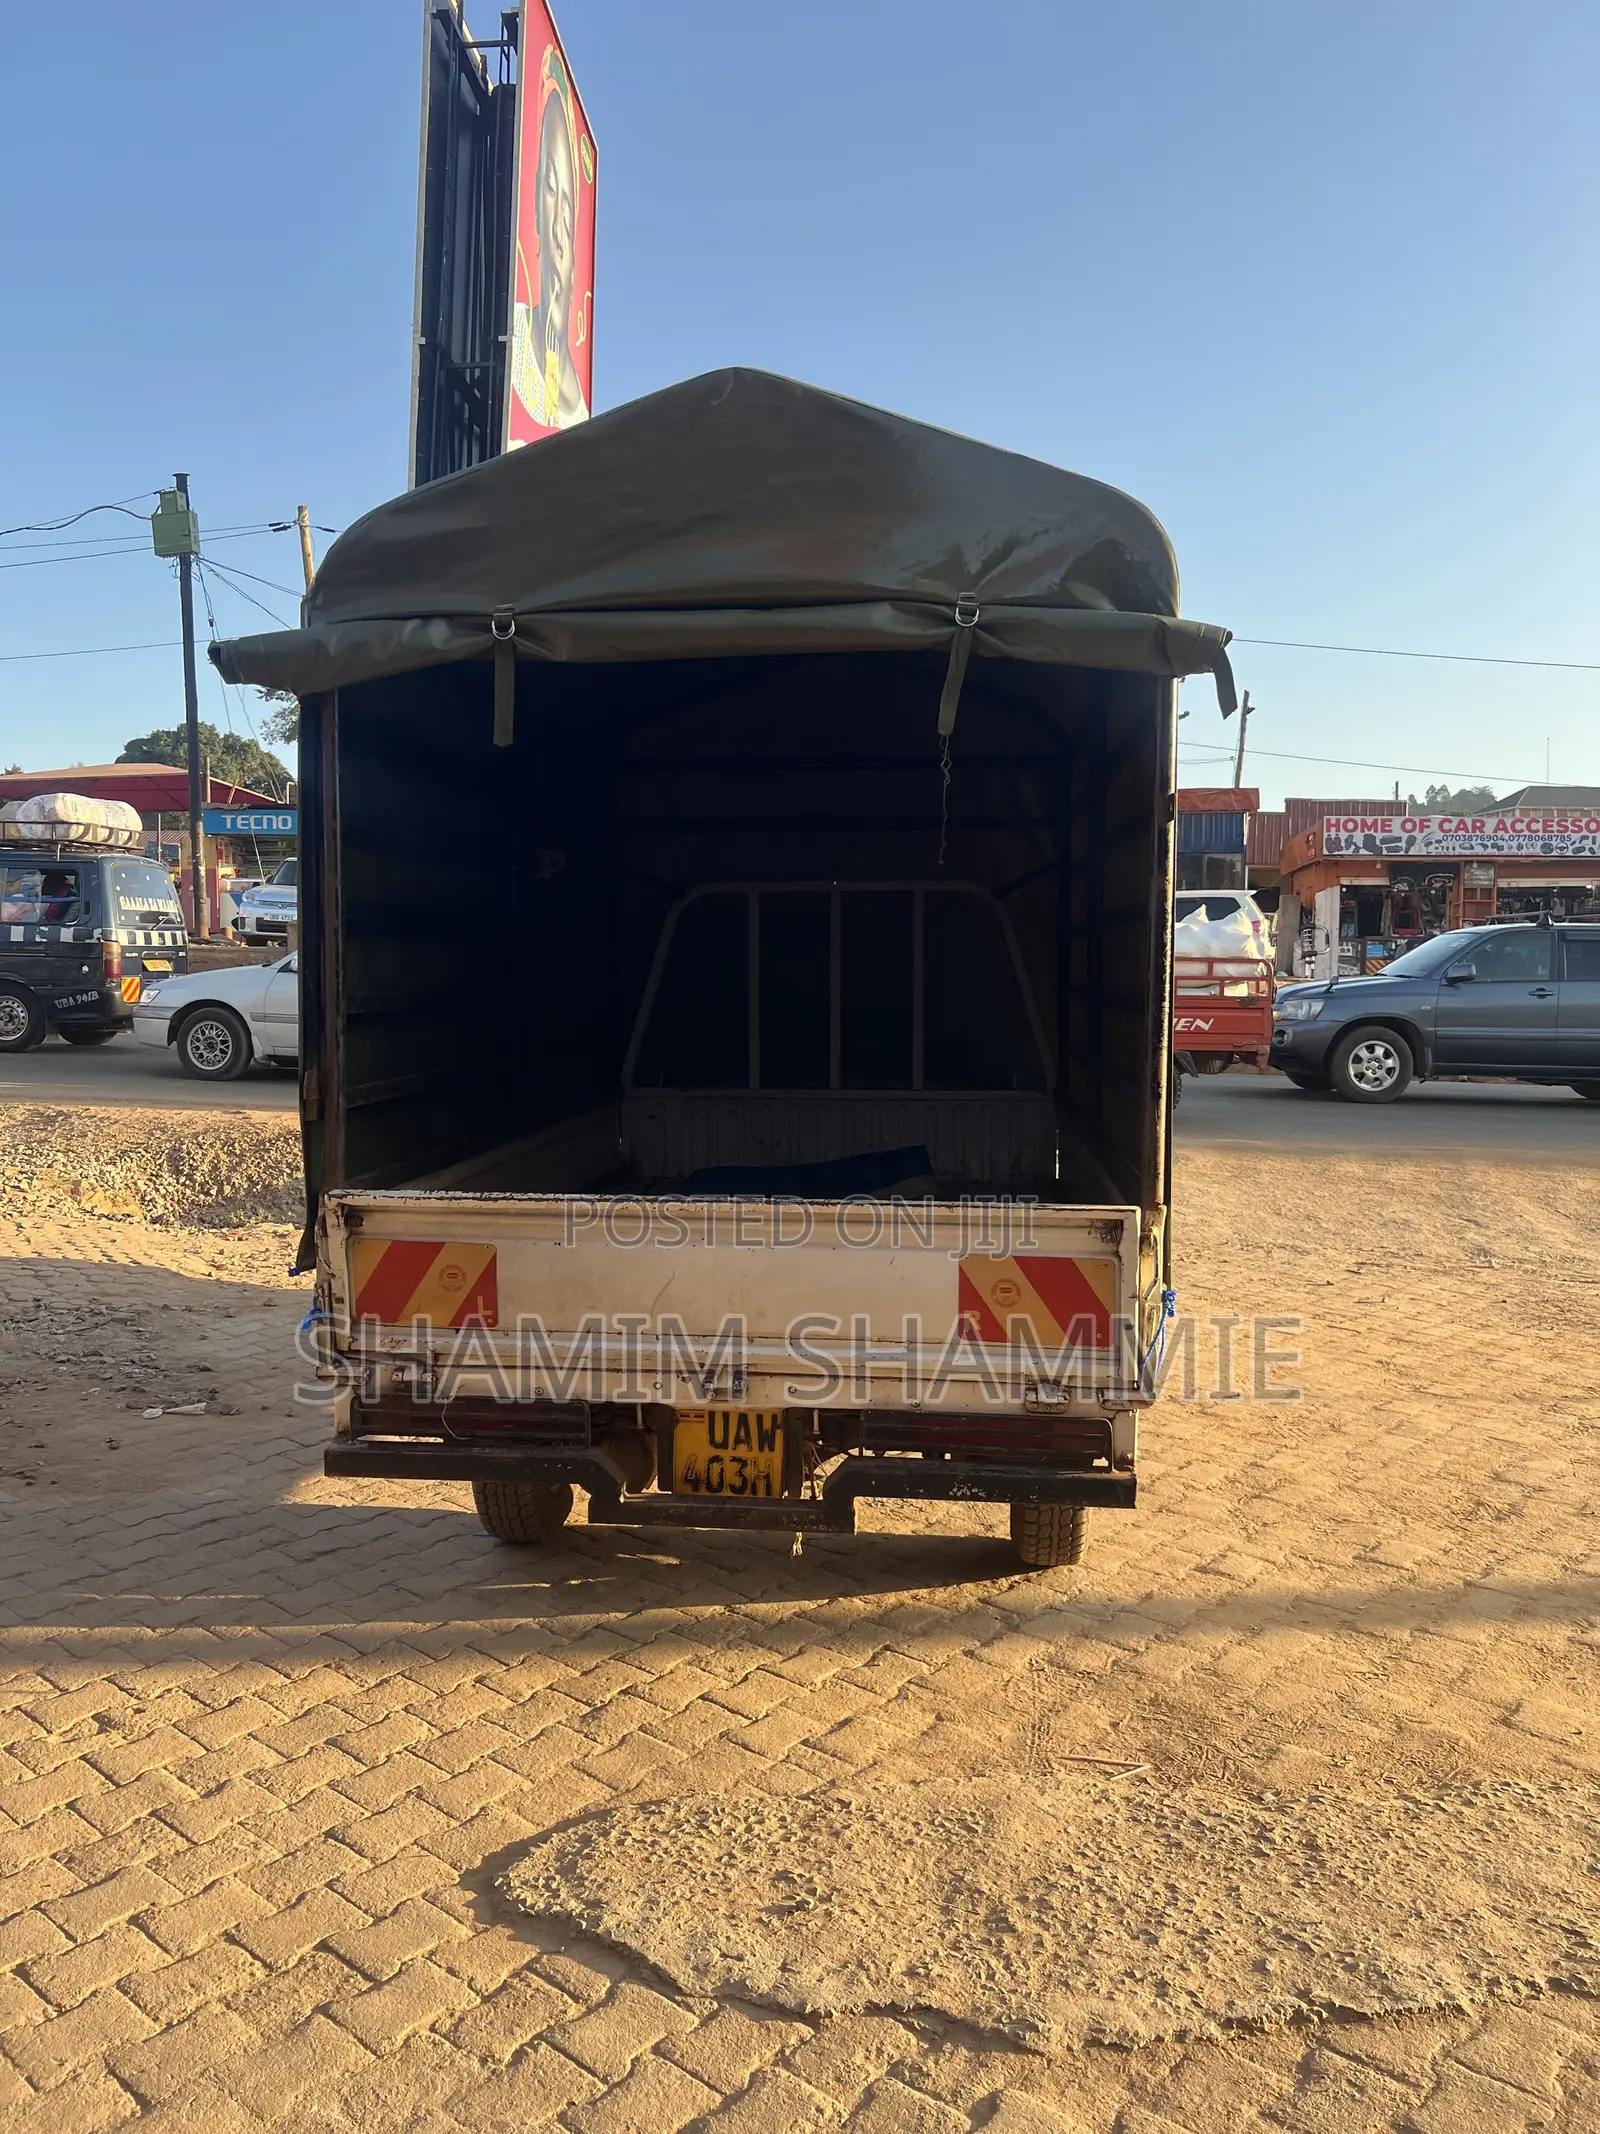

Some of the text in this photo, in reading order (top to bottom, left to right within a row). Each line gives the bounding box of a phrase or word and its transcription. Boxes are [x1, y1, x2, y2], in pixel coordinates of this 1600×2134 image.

[222, 814, 293, 830] TECNO
[1325, 817, 1600, 834] HOME OF CAR ACCESSO
[54, 998, 76, 1009] UBA
[708, 1411, 778, 1452] UAW
